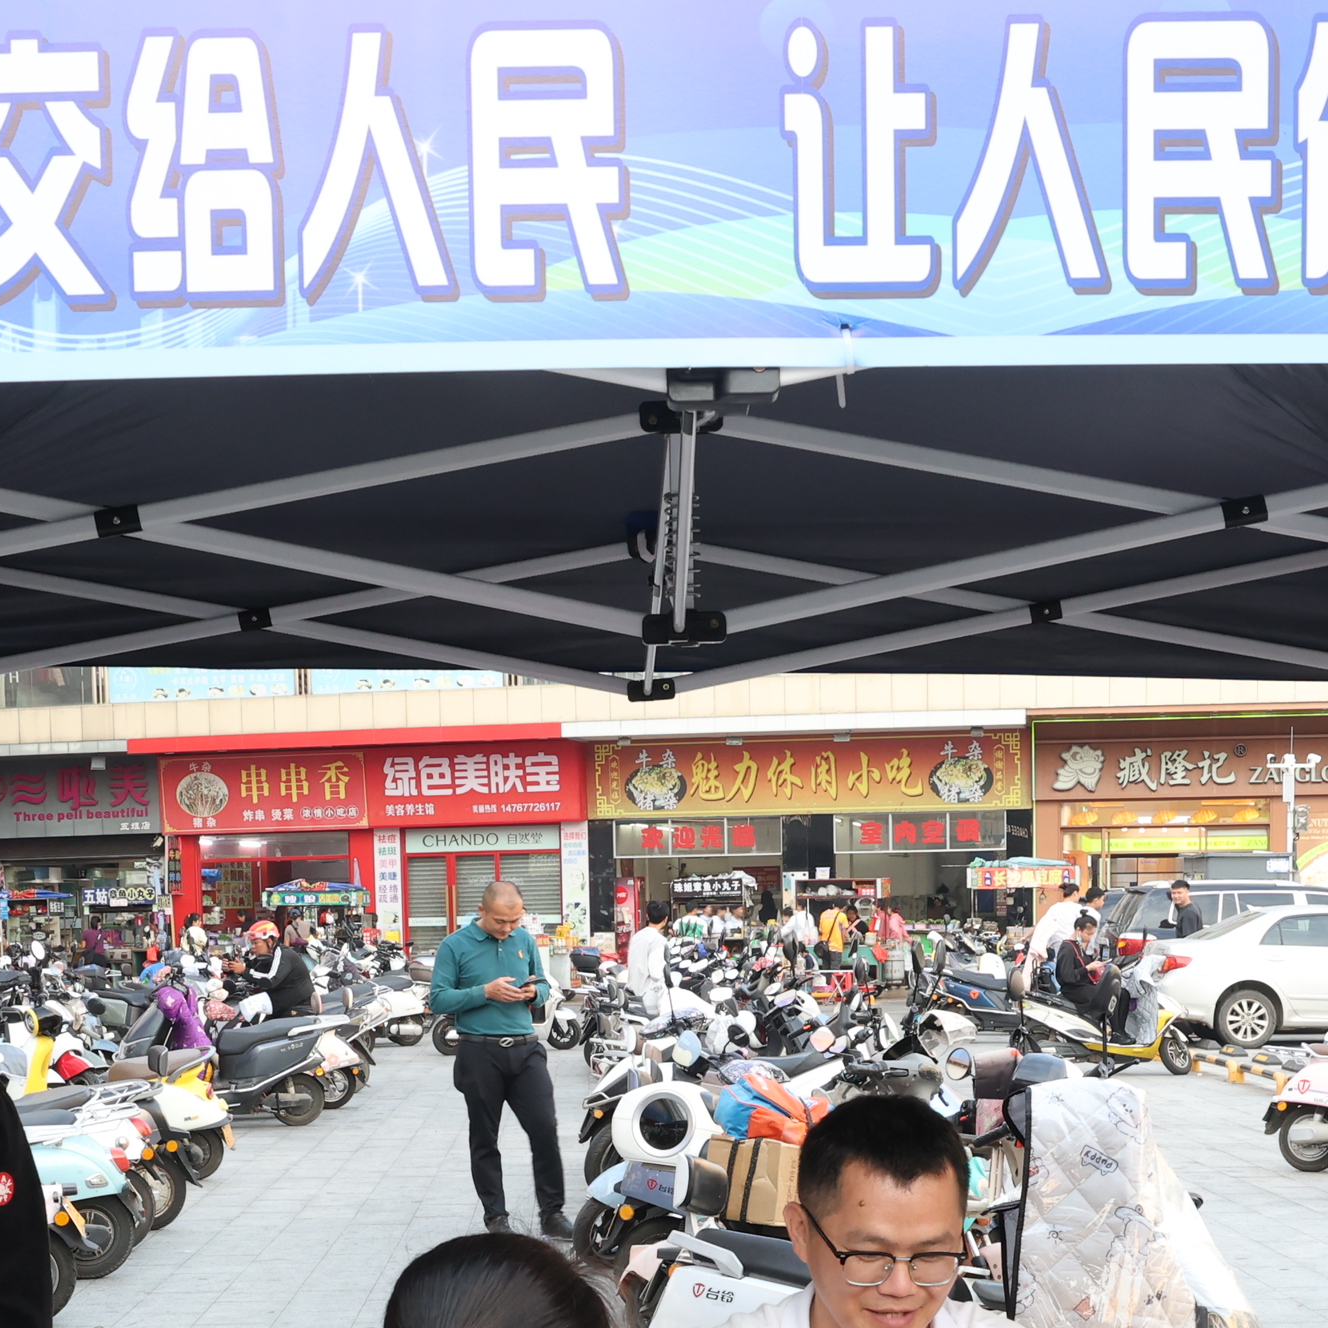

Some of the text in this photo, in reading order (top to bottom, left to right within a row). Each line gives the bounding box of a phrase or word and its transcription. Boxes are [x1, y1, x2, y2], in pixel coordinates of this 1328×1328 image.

[635, 749, 677, 769] 牛杂
[940, 740, 984, 761] 牛杂
[240, 760, 351, 804] 串串香
[383, 752, 561, 797] 绿色美肤宝
[690, 748, 924, 804] 魅力休闲小吃
[635, 792, 678, 811] 猪杂
[939, 784, 984, 804] 猪杂
[13, 807, 149, 823] Three pell beautiful
[242, 809, 266, 822] 炸串
[272, 808, 295, 821] 烫菜
[385, 803, 435, 816] 美容养生馆
[500, 802, 561, 814] 14767726117
[860, 817, 981, 845] 室内空调
[1307, 817, 1328, 827] NUT
[422, 831, 543, 848] CHANDO 自然堂
[640, 824, 756, 849] 欢迎光临
[378, 859, 398, 868] 美甲
[705, 1287, 735, 1304] 台铃
